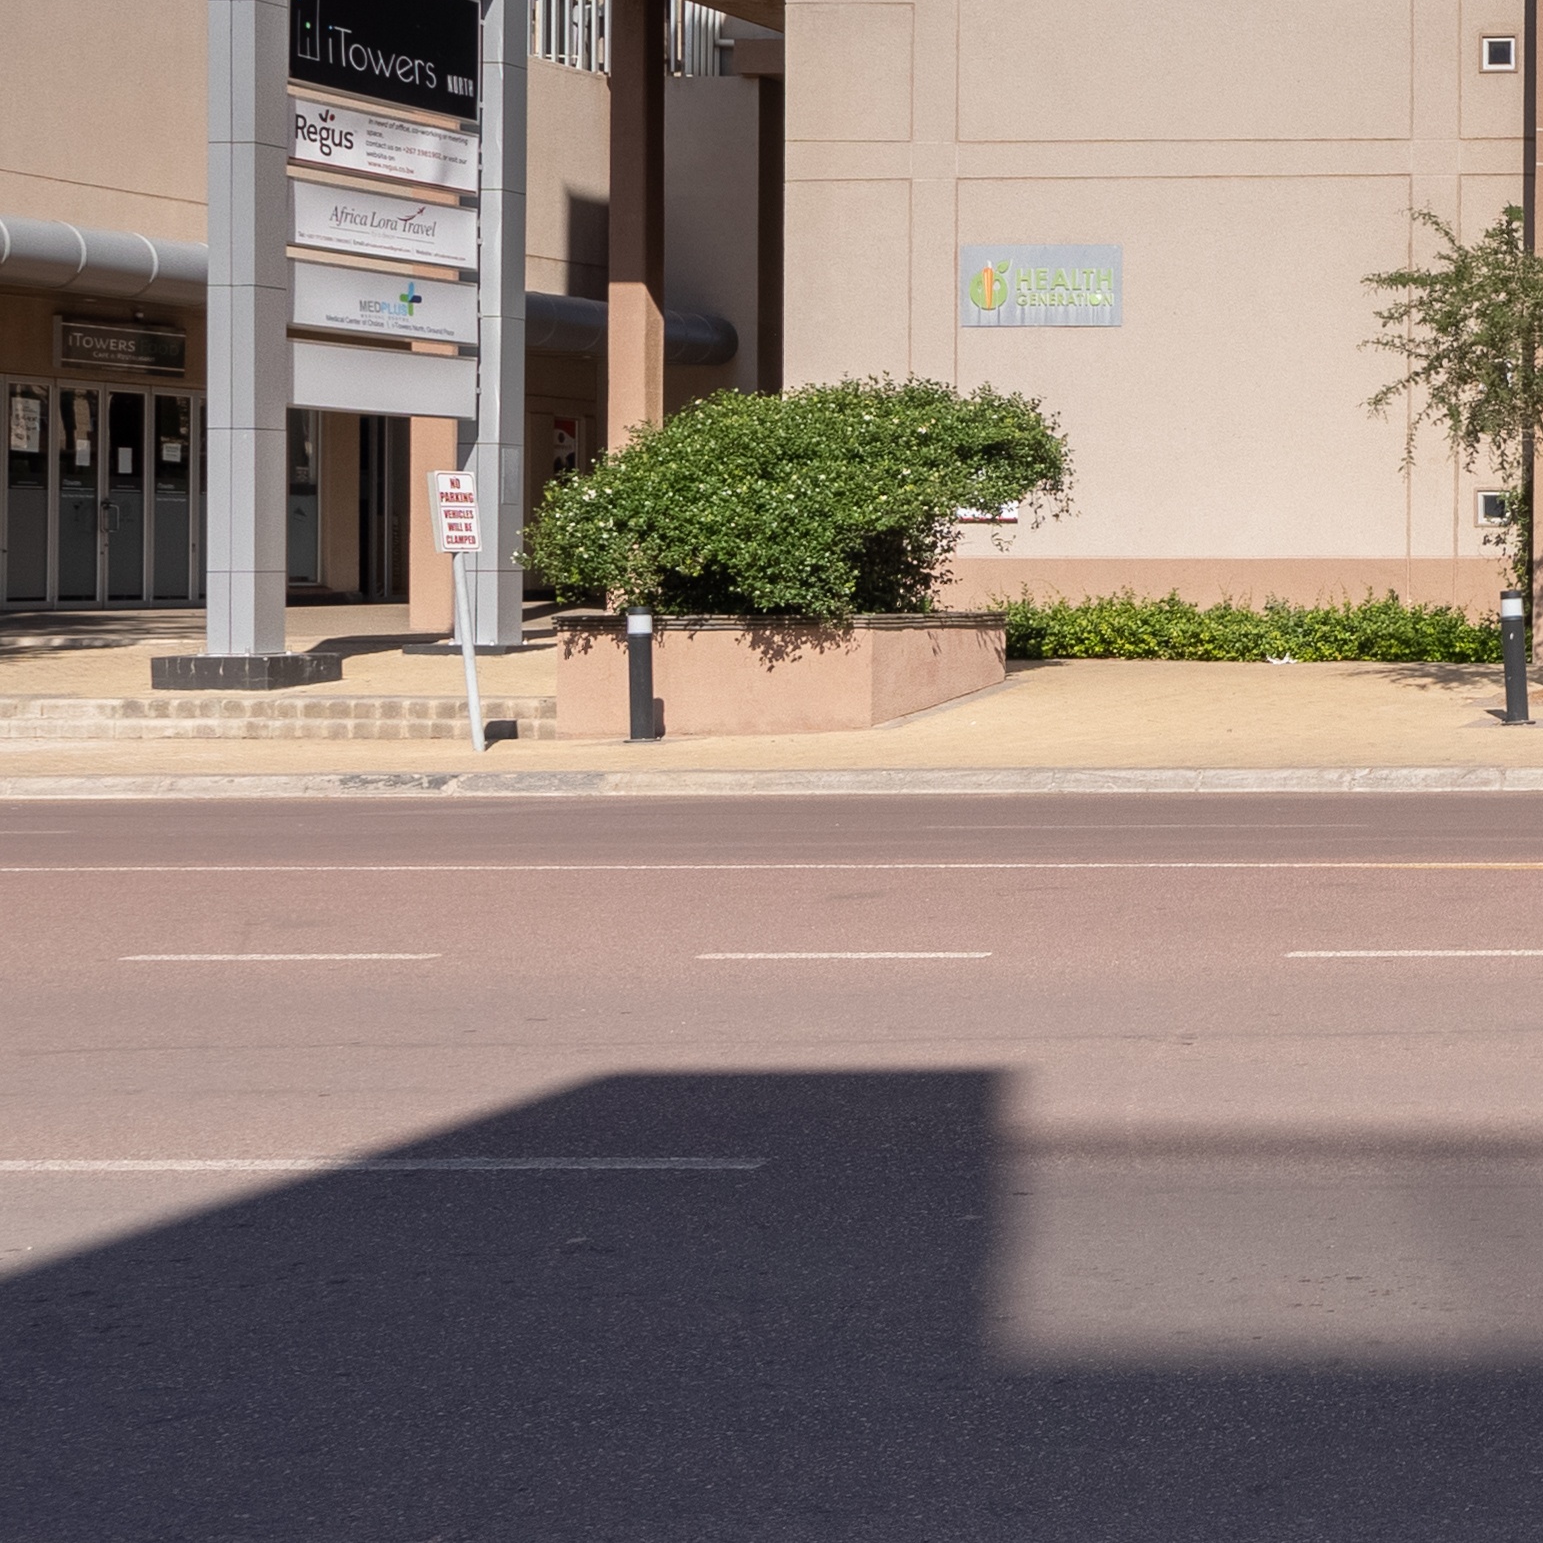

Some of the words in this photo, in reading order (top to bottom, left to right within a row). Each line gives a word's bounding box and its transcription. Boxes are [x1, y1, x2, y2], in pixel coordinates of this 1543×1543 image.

[328, 25, 437, 89] iTowers
[446, 74, 475, 98] NORTH
[295, 113, 354, 156] Regus
[329, 205, 368, 227] Africa
[369, 211, 398, 231] Lora
[398, 217, 437, 237] Travel
[1016, 268, 1113, 291] HEALTH
[1016, 291, 1114, 307] GENERATION
[359, 300, 408, 317] MEDPLUS
[449, 477, 461, 490] NO
[440, 491, 474, 503] PARKING
[443, 509, 474, 519] VEHICLES
[447, 522, 463, 532] WILL
[464, 522, 472, 532] BE
[446, 534, 476, 545] CLAMPED
